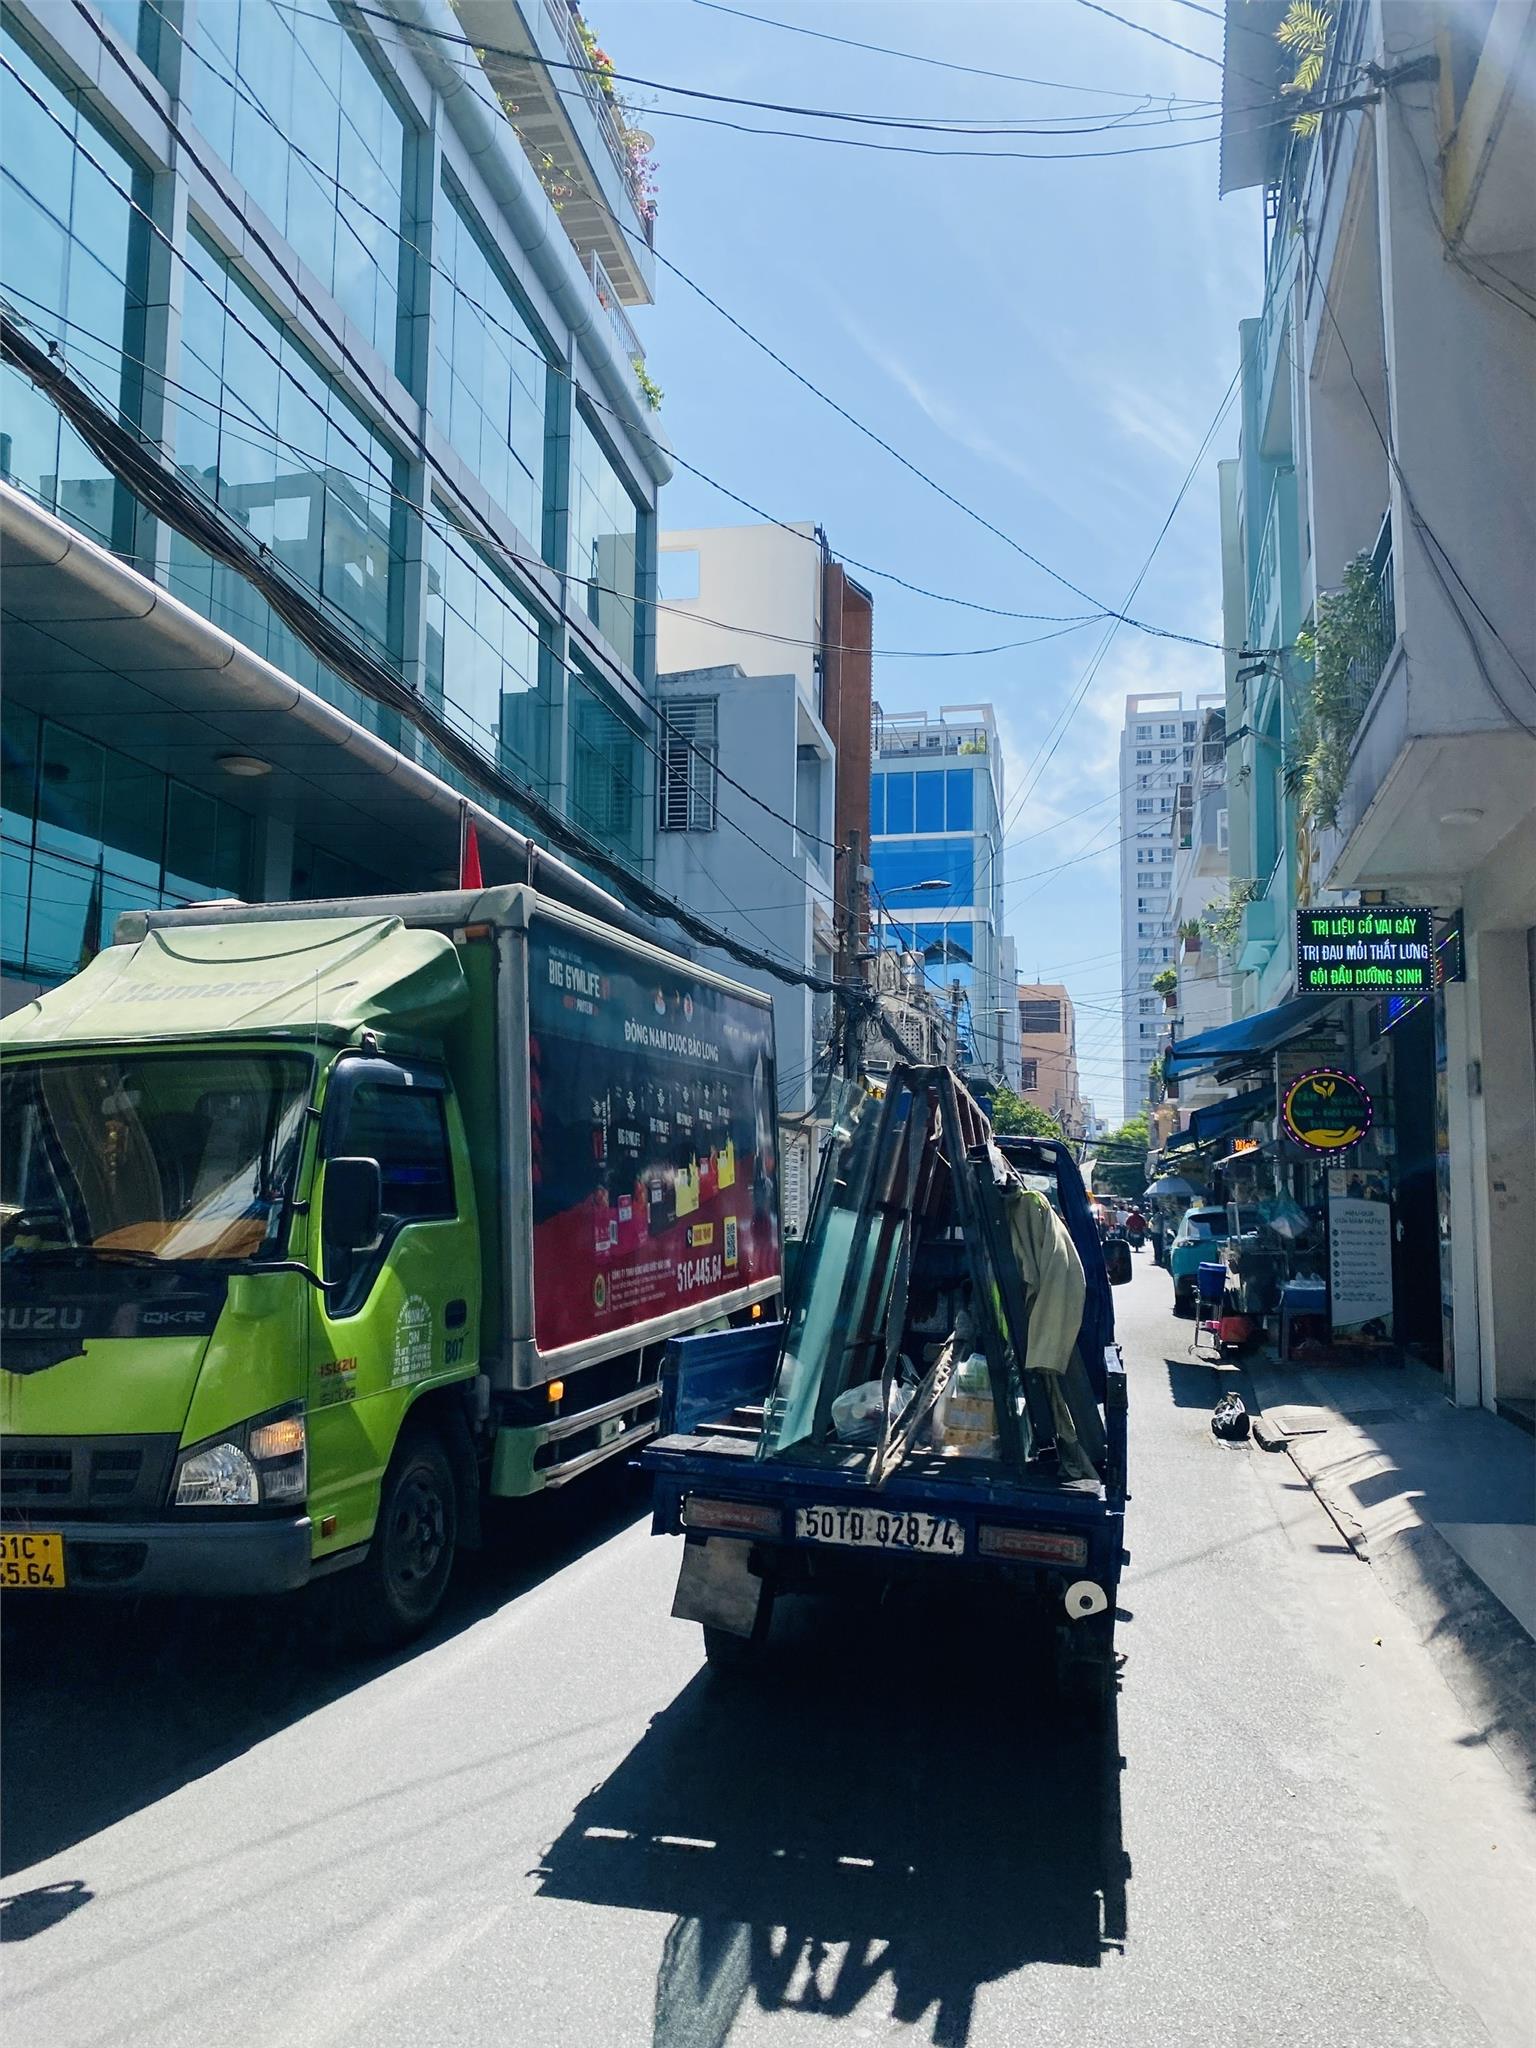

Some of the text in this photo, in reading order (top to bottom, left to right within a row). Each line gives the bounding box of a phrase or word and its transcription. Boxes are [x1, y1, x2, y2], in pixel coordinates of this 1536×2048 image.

[1312, 919, 1329, 937] TRỊ
[1332, 917, 1354, 937] LIỆU
[1375, 919, 1392, 934] VAI
[1395, 916, 1417, 934] GÁY
[1302, 938, 1428, 962] TRỊ ĐAU MỎI THẮT LƯNG
[548, 959, 564, 987] BIG
[565, 964, 600, 998] GYMLIFE
[1310, 967, 1327, 987] GỘI
[1331, 964, 1352, 985] ĐẦU
[1356, 966, 1393, 985] DƯỠNG
[1396, 968, 1422, 985] SINH
[625, 1017, 649, 1043] ĐÔNG
[650, 1027, 667, 1049] NAM
[702, 1041, 719, 1062] LONG
[677, 1254, 722, 1292] 51C-445.64
[319, 1357, 357, 1377] ISUZU
